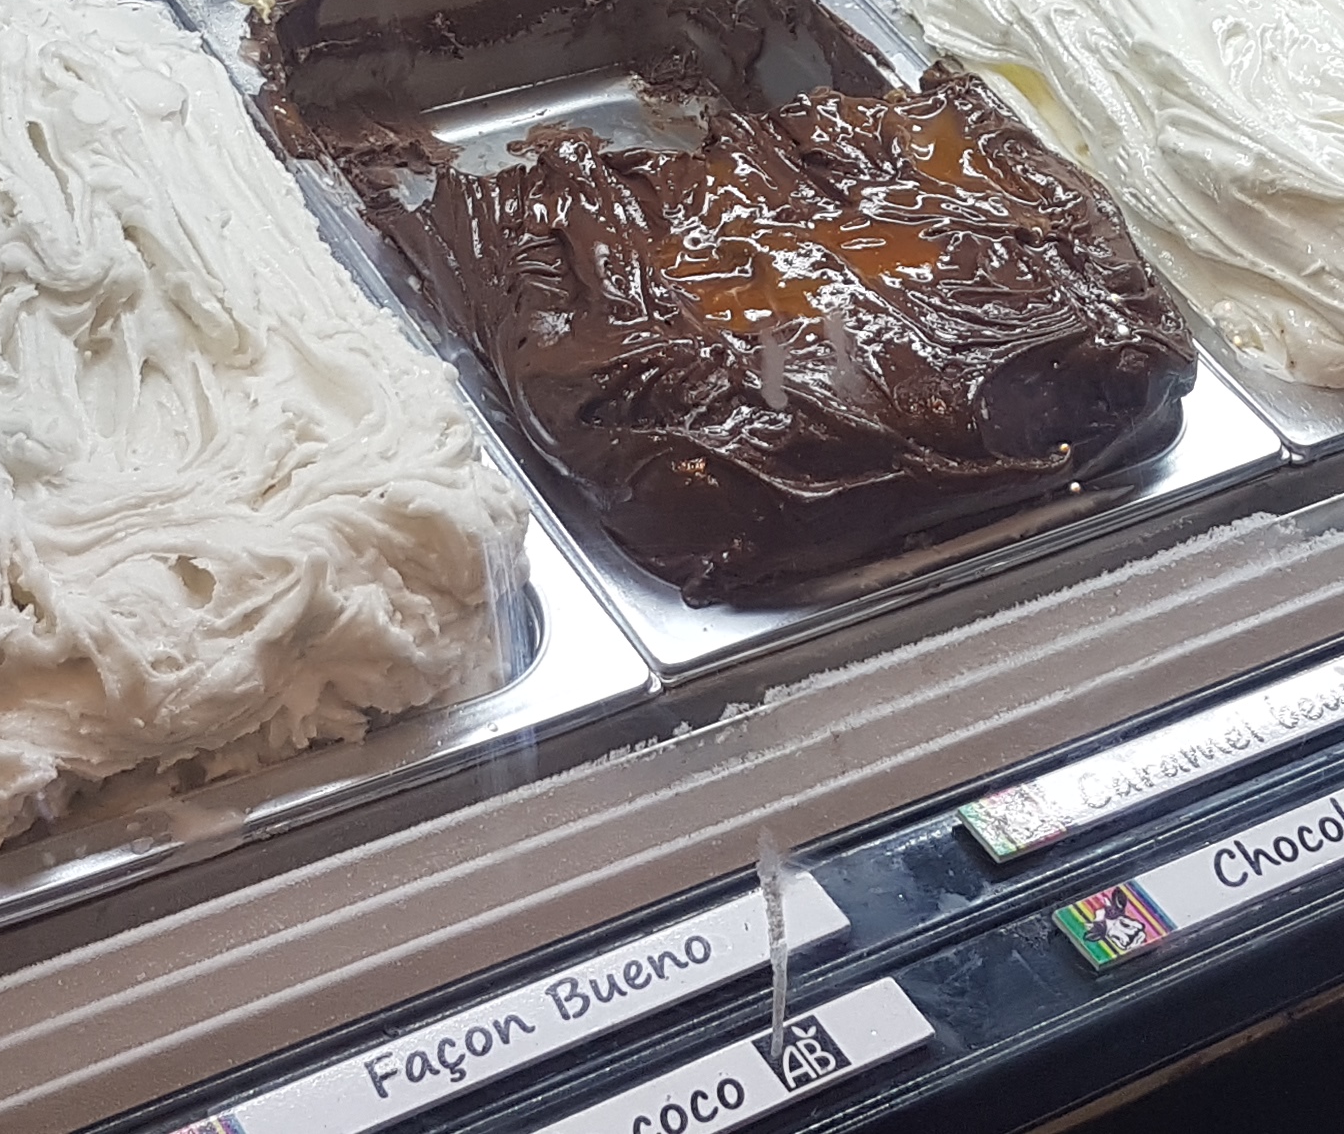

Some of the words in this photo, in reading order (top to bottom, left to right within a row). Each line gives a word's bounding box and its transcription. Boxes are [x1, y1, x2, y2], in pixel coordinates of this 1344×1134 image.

[1077, 712, 1266, 810] Caramel
[363, 1013, 537, 1099] Façon
[544, 934, 713, 1022] Bueno
